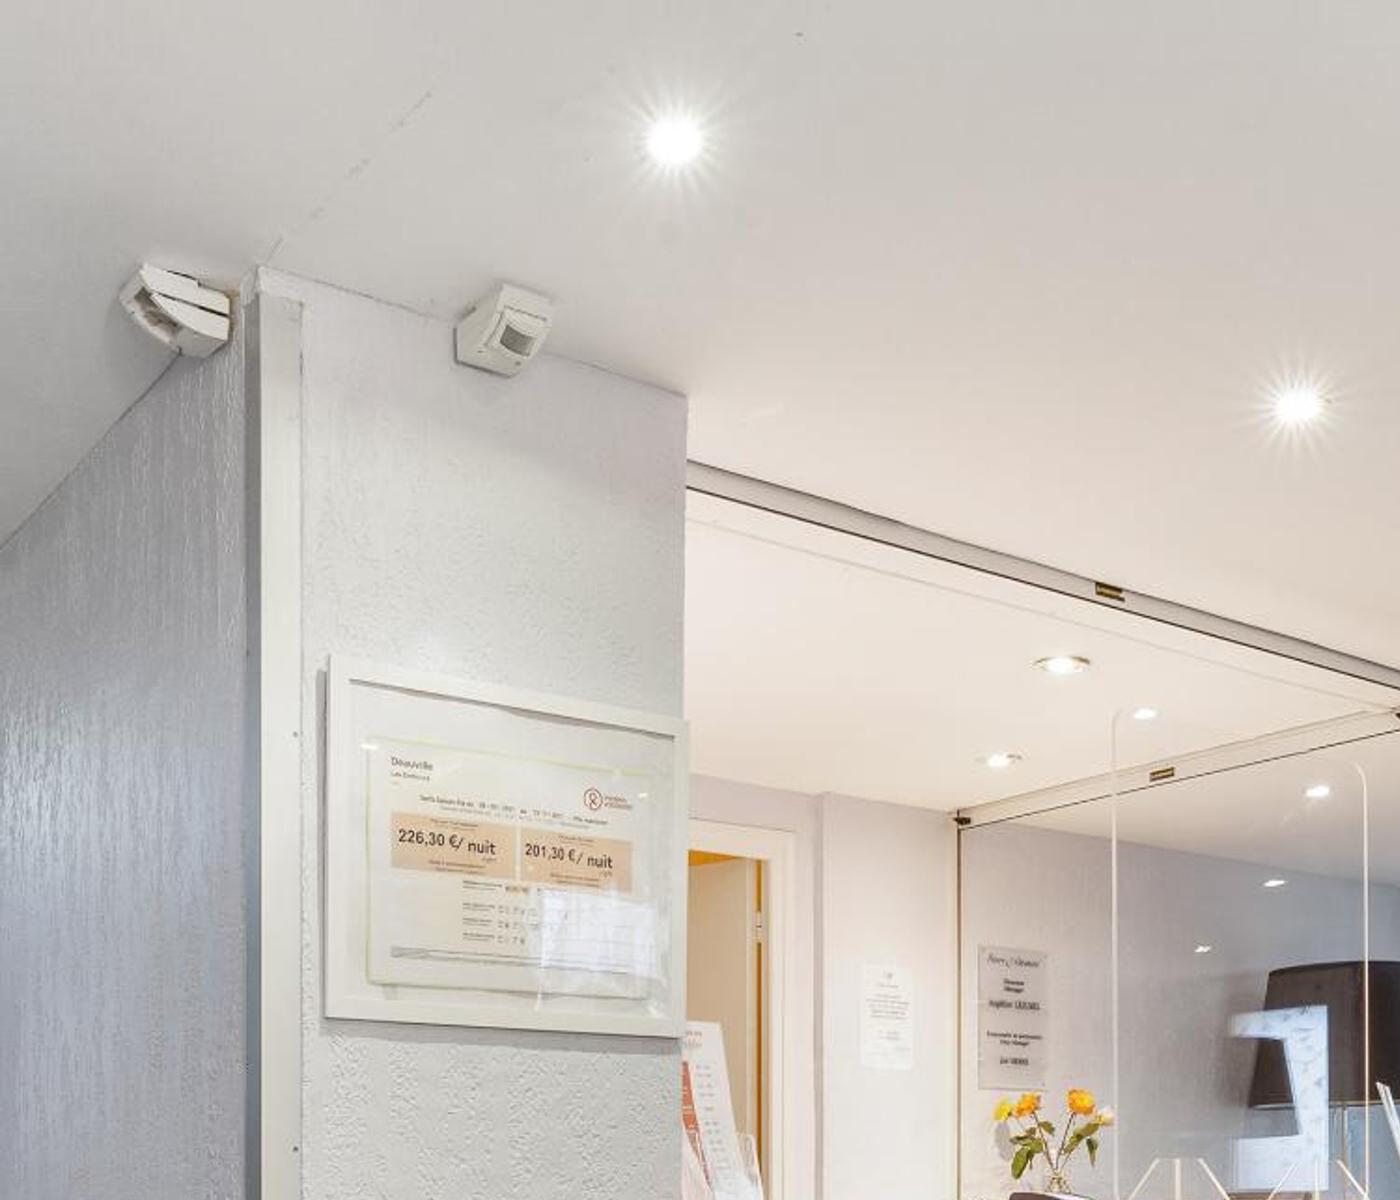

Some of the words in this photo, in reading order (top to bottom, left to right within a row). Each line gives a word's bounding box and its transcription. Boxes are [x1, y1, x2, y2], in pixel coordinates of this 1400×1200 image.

[398, 828, 446, 847] 226,30
[467, 839, 497, 856] nuit
[524, 842, 565, 861] 201,30
[586, 853, 614, 869] nuit
